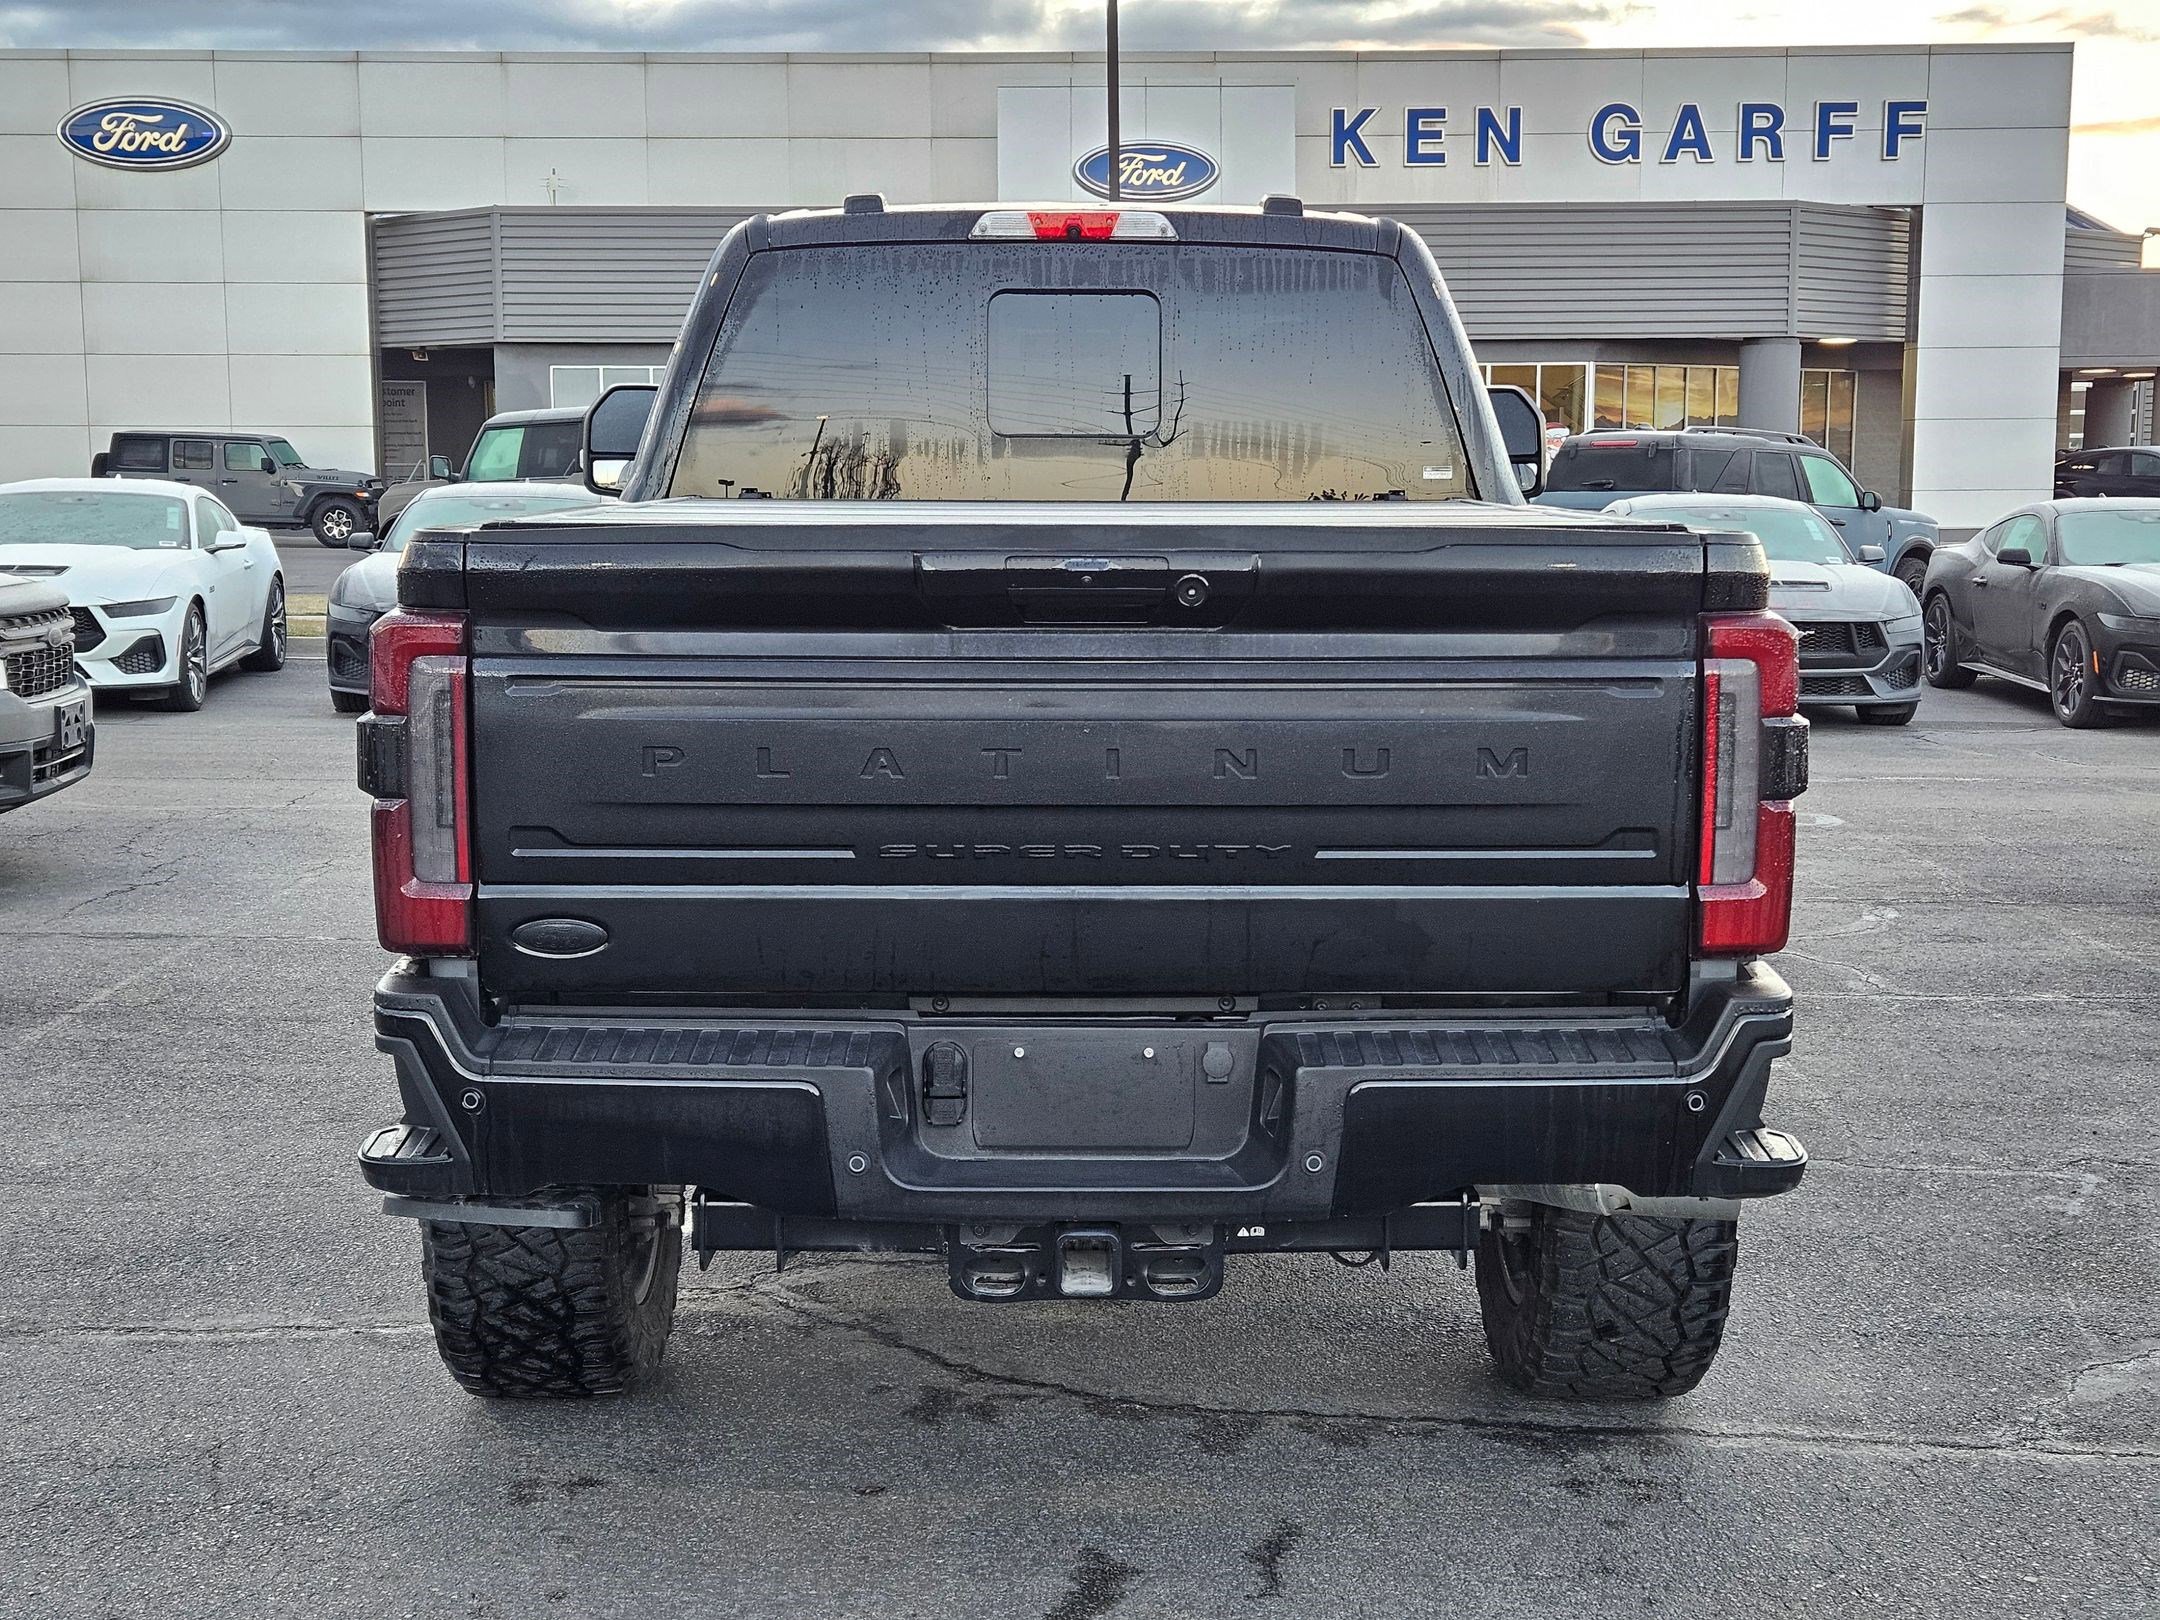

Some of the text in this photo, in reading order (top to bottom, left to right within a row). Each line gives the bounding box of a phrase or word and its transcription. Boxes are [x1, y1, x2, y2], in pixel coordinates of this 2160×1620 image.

[93, 112, 188, 152] Ford
[1329, 101, 1928, 168] KEN GARFF
[1108, 152, 1187, 186] Ford
[642, 745, 1530, 782] PLATINUM
[879, 843, 1292, 860] SUPER DUTY
